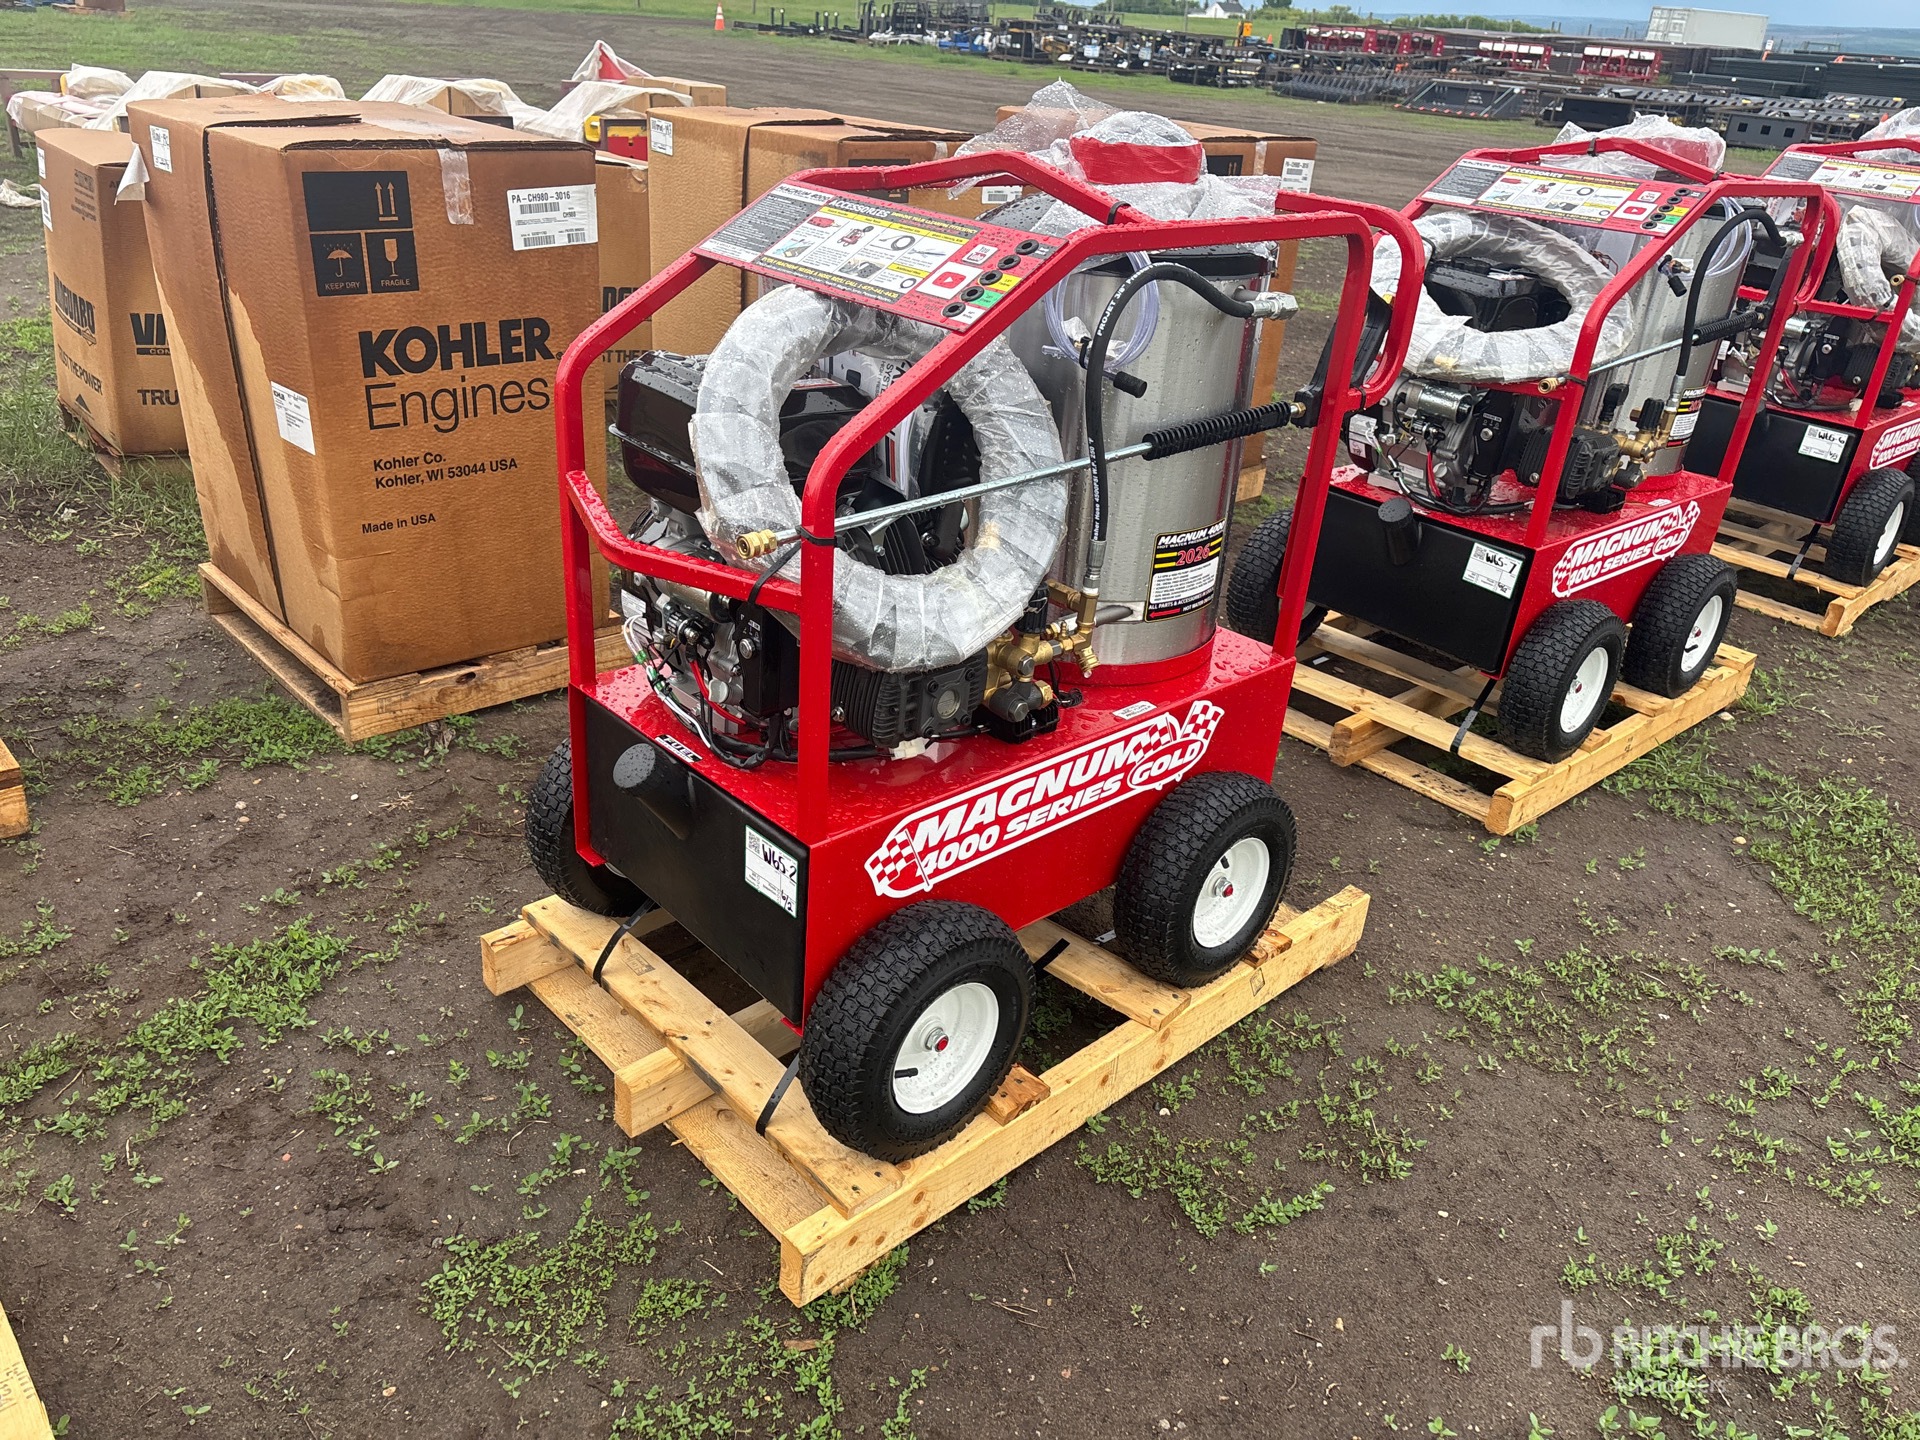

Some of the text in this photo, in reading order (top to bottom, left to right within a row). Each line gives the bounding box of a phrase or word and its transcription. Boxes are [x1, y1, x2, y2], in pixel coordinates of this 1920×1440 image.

[511, 191, 571, 203] PA-CH980-3016
[829, 199, 891, 218] ACCESSORIES
[324, 281, 361, 291] KEEP DRY
[381, 278, 411, 287] FRAGILE
[1097, 300, 1116, 337] PROJET
[358, 317, 555, 378] KOHLER
[365, 375, 550, 434] Engines
[373, 452, 447, 472] Kohler Co.
[375, 458, 518, 490] Kohler, WI 53044 USA
[362, 513, 437, 535] Made in USA
[1157, 528, 1208, 546] MAGNUM
[1176, 542, 1211, 566] 2026
[1571, 517, 1687, 568] MAGNUM GOLD
[1601, 542, 1653, 573] SERIES
[660, 735, 698, 761] FUEL
[908, 735, 1201, 850] MAGNUM GOLD
[915, 773, 1123, 880] 4000 SERIES
